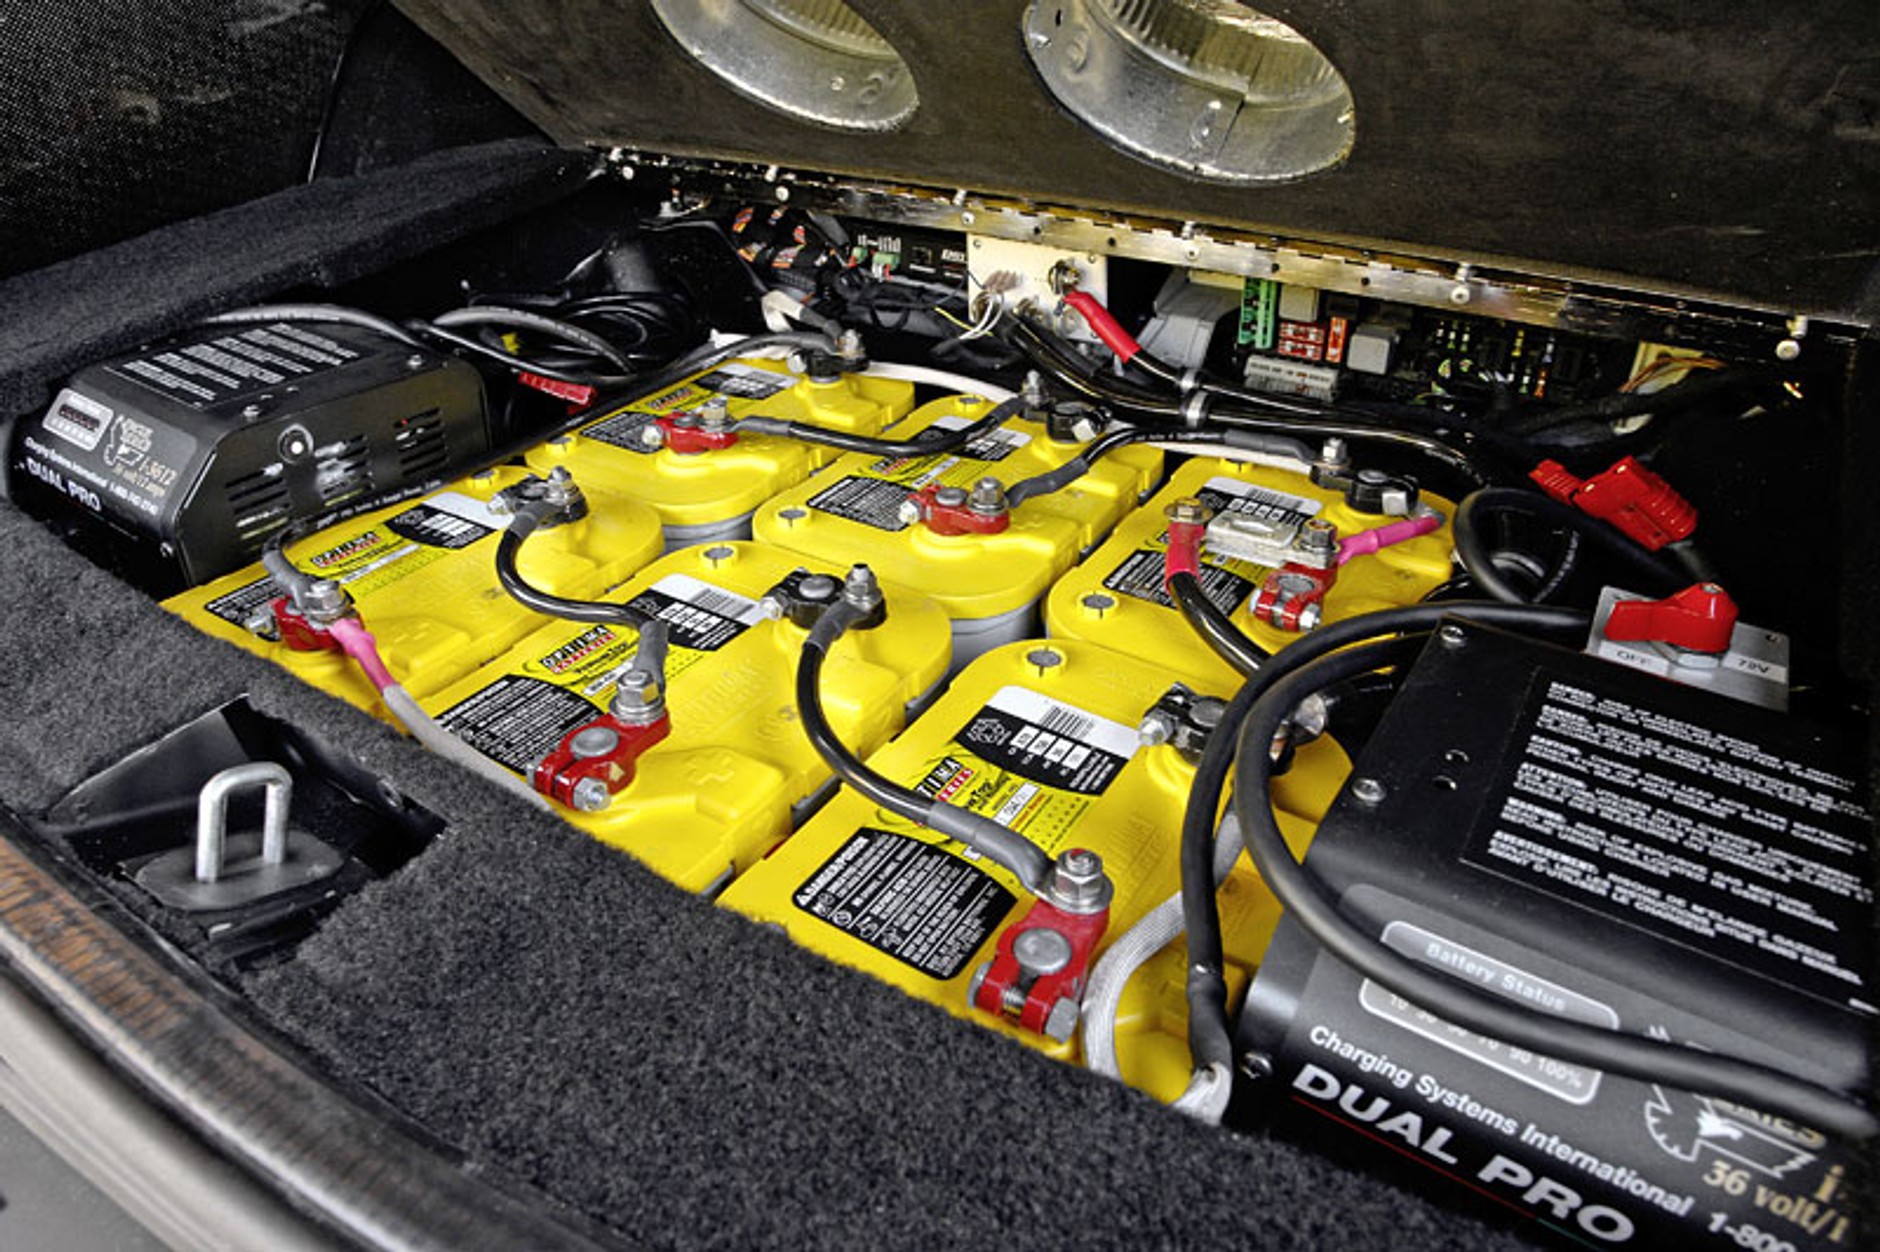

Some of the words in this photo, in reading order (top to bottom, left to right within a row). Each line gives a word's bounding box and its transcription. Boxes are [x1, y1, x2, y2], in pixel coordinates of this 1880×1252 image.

[26, 456, 67, 493] DUAL
[67, 479, 102, 512] PRO
[1426, 942, 1498, 983] Battery
[1501, 974, 1567, 1012] Status
[1538, 1056, 1583, 1089] 100%
[1309, 1025, 1413, 1088] Charging
[1414, 1074, 1519, 1136] Systems
[1520, 1122, 1694, 1217] International
[1293, 1063, 1458, 1165] DUAL
[1477, 1154, 1635, 1243] PRO
[1702, 1160, 1751, 1196] 36
